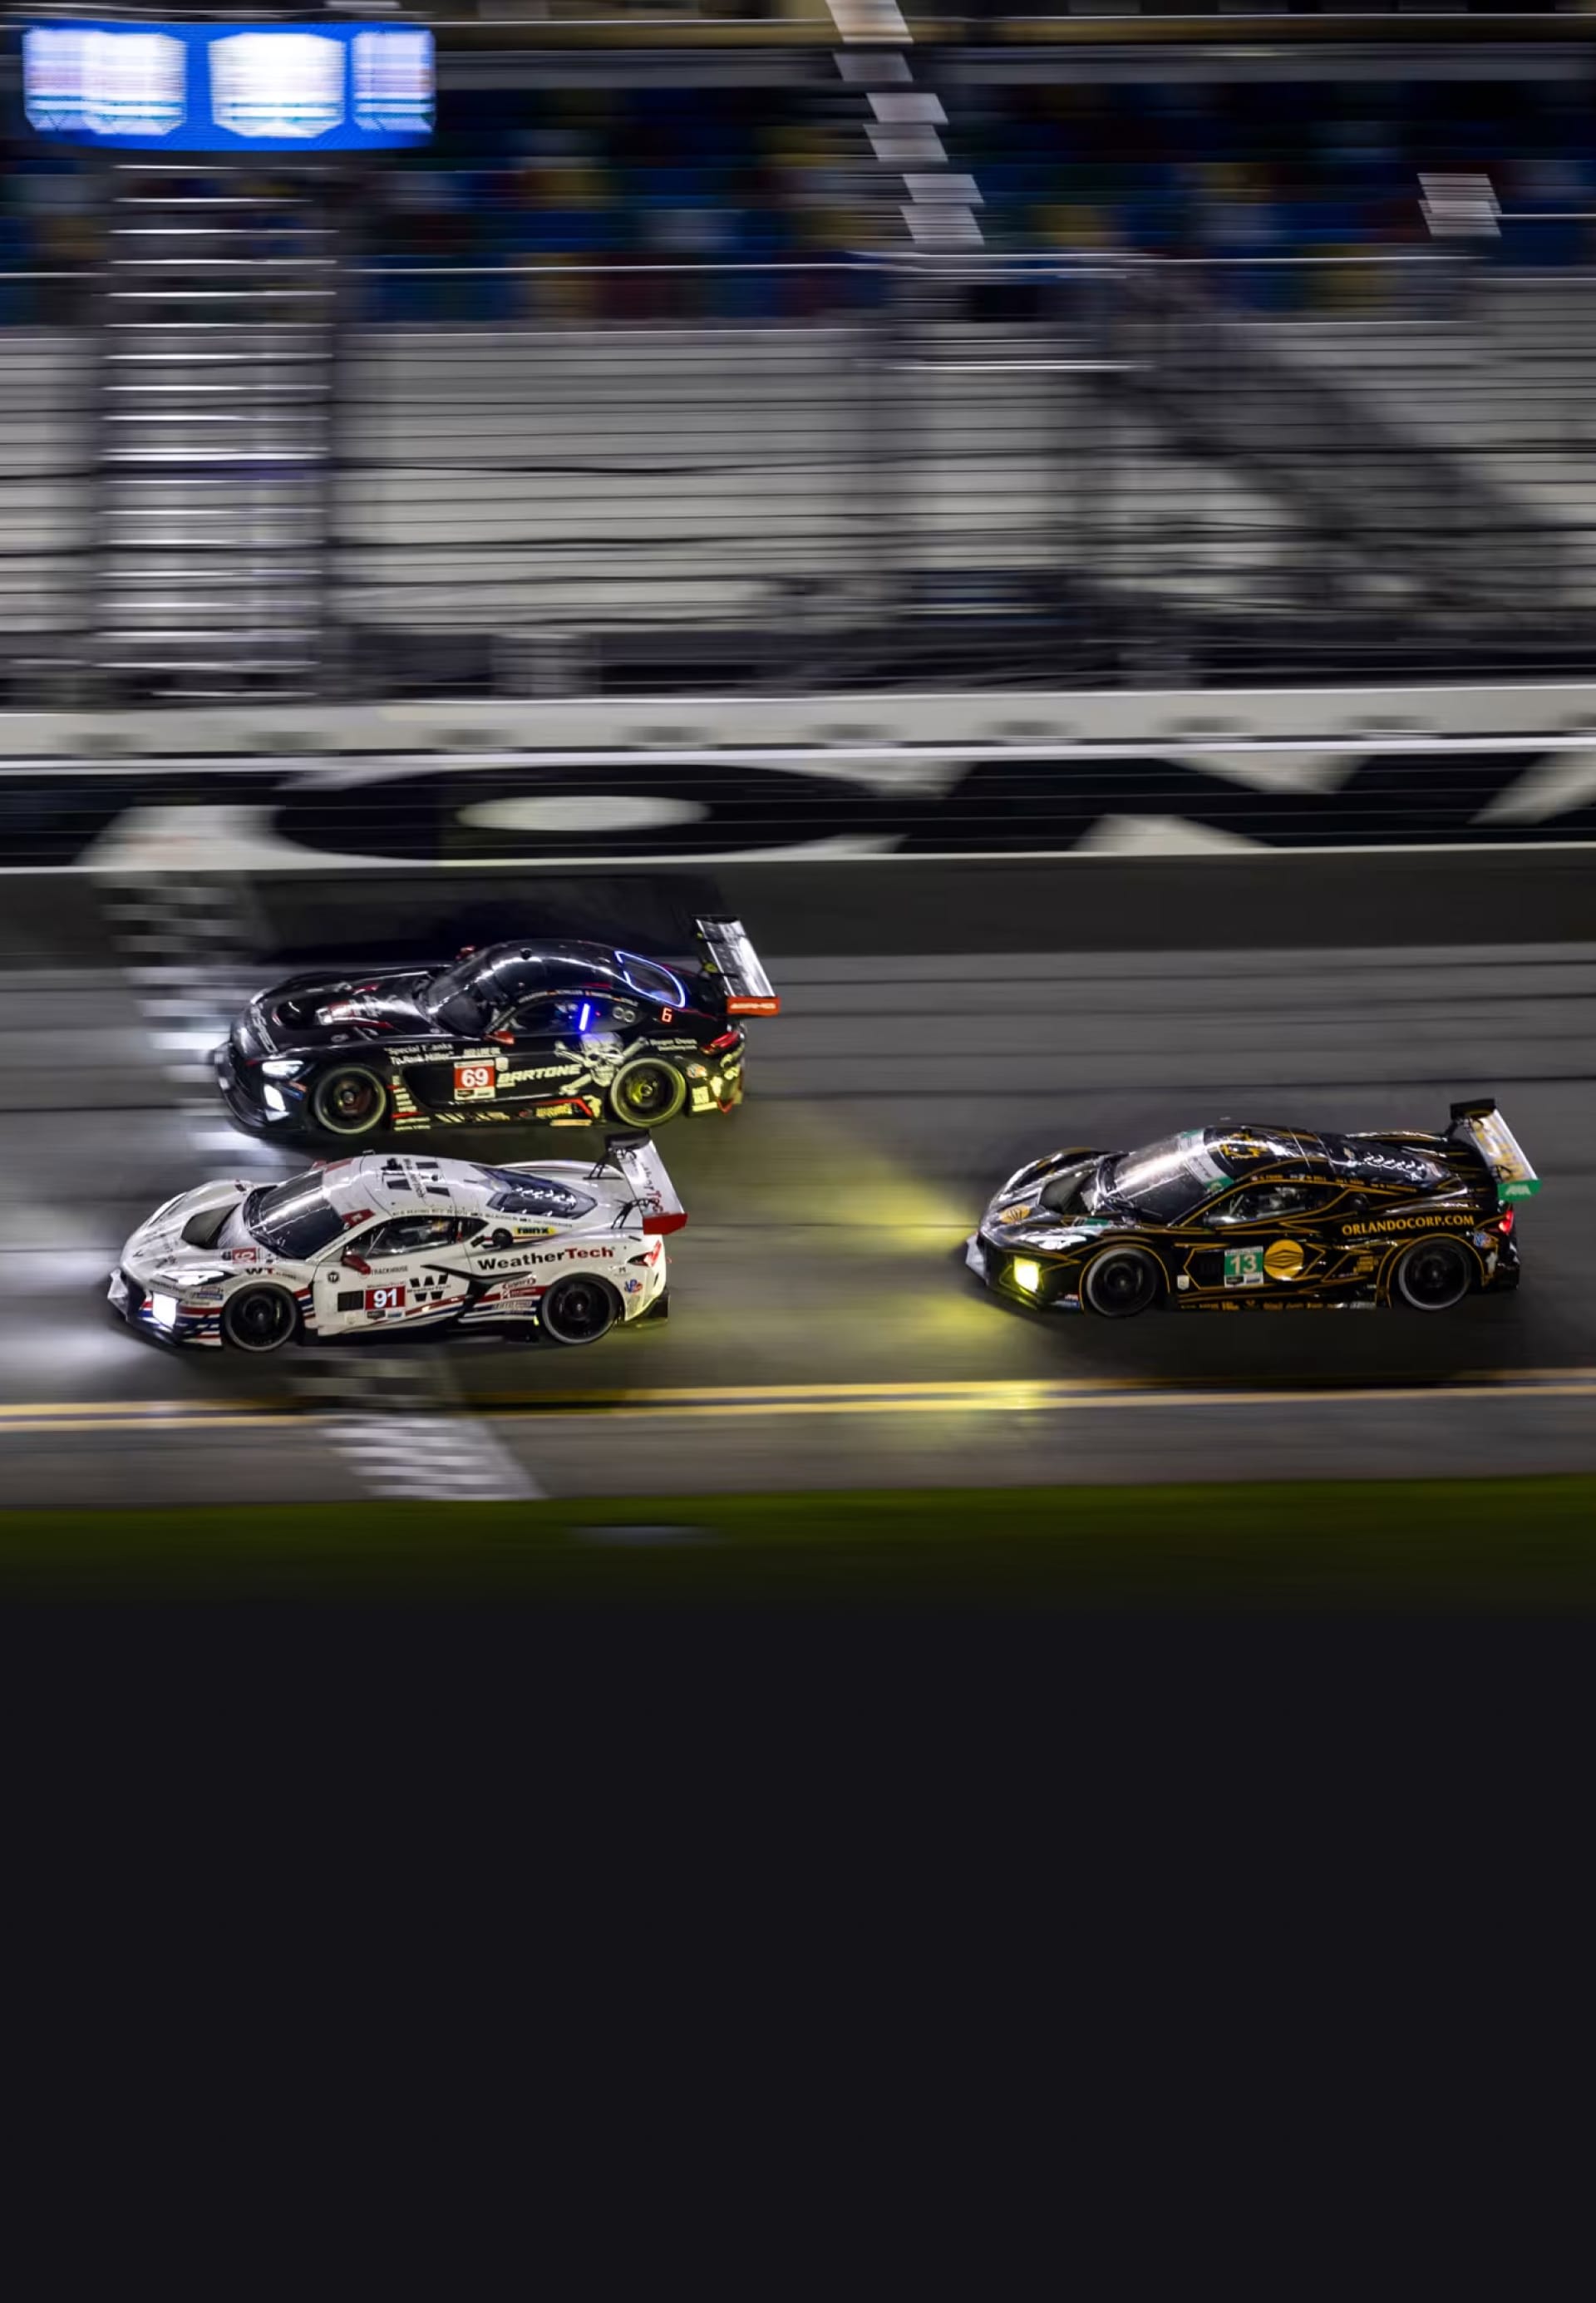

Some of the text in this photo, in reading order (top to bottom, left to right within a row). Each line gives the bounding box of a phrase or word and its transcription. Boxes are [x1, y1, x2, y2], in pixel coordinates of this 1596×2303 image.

[662, 1008, 672, 1023] 6
[461, 1068, 489, 1087] 69
[497, 1064, 583, 1082] BARTONE
[1341, 1215, 1475, 1236] ORLANDOCORP.COM
[477, 1246, 614, 1270] WeatherTech
[1230, 1255, 1258, 1275] 13
[373, 1288, 397, 1309] 91
